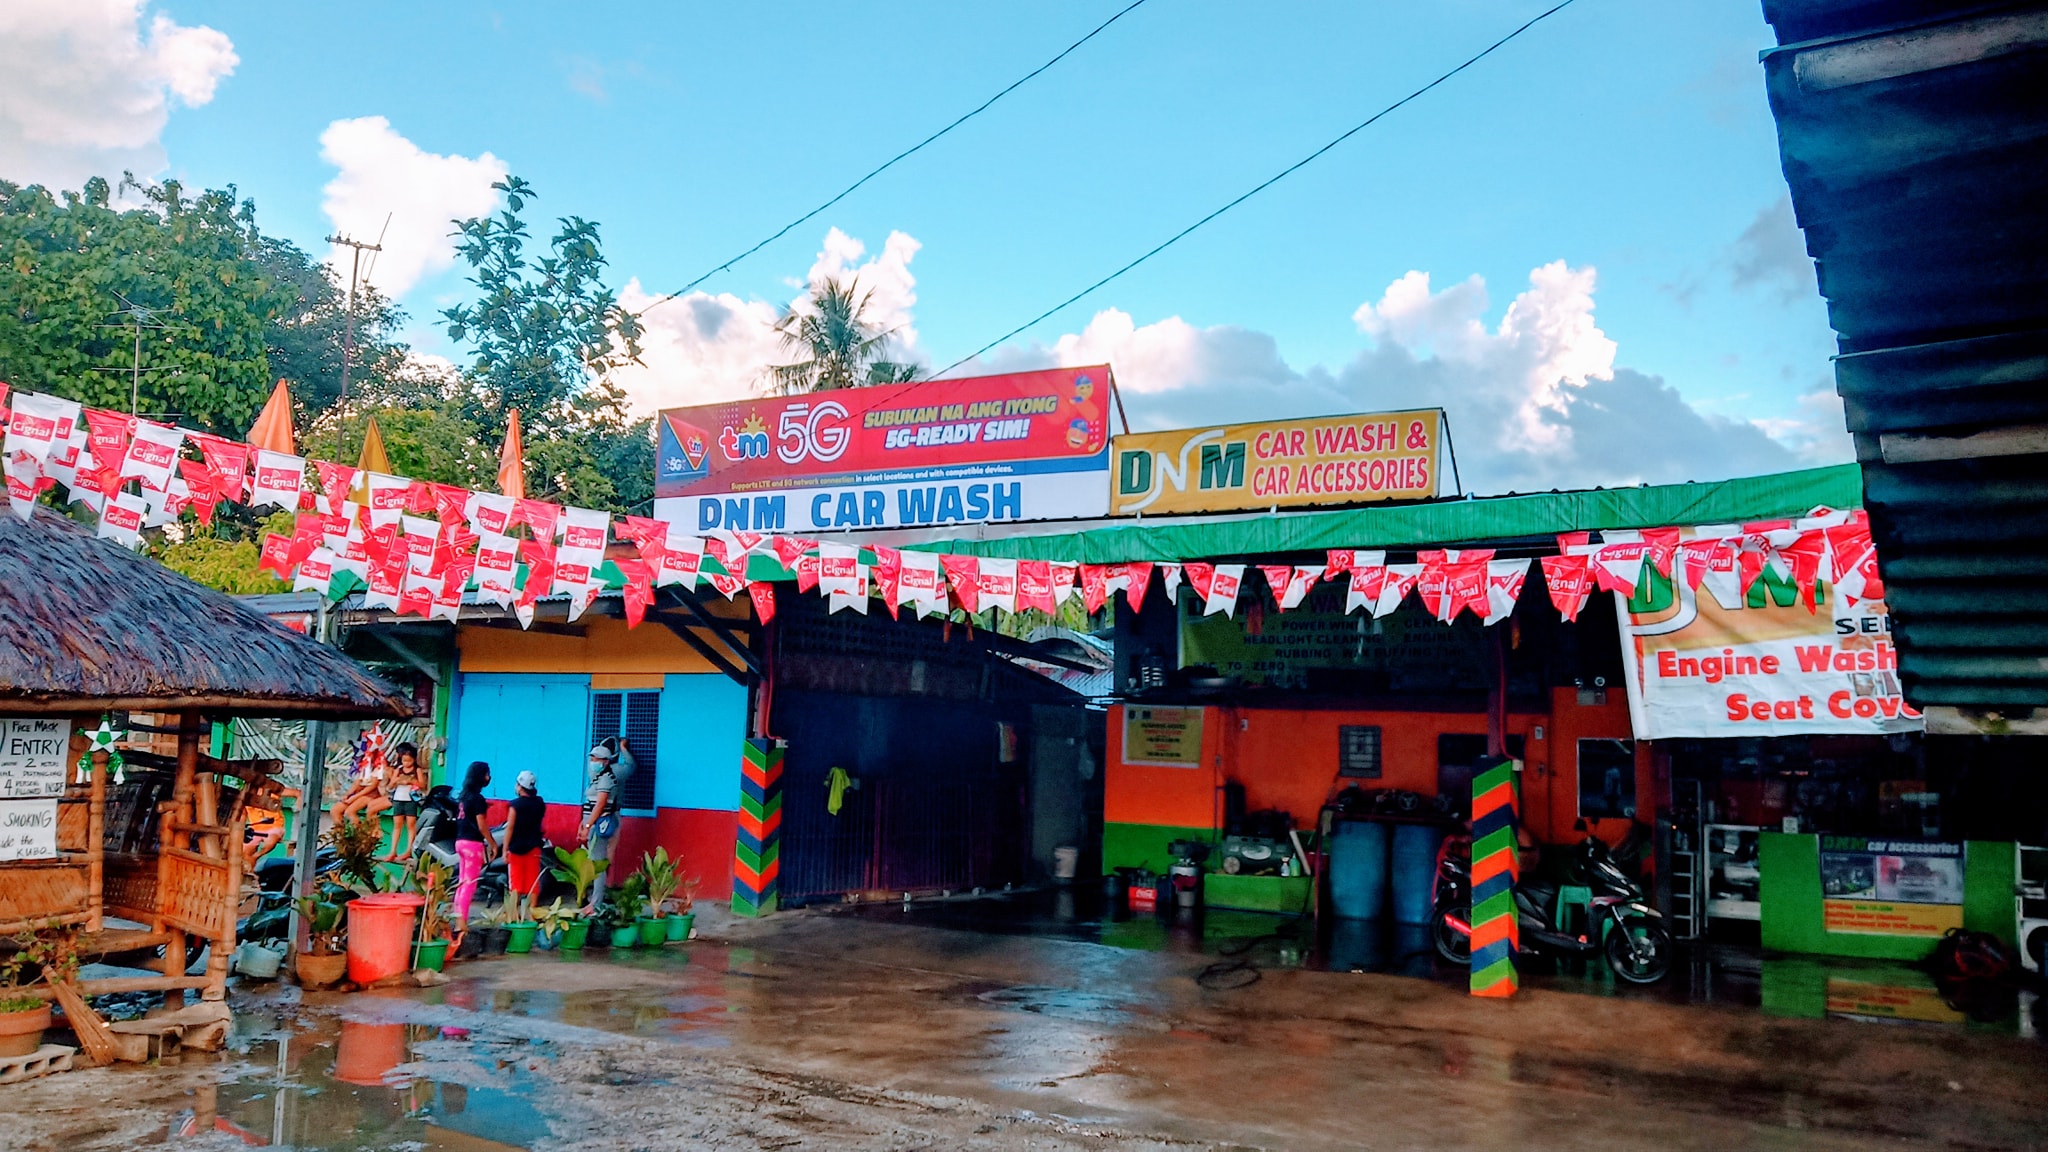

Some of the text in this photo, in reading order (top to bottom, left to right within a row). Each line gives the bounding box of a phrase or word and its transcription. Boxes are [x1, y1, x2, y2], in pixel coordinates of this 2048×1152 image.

[863, 396, 1058, 429] SUBUKAN NA ANG IYONG
[12, 422, 51, 438] Cignal
[719, 400, 850, 464] tm 5G
[884, 418, 1031, 450] 5G-READY SIM!
[93, 434, 119, 446] gnal
[1255, 420, 1428, 459] CAR WASH &
[133, 447, 170, 465] Cignal
[793, 478, 820, 486] network
[863, 474, 883, 482] select
[884, 471, 914, 481] locations
[915, 470, 928, 478] and
[929, 468, 945, 477] with
[945, 466, 984, 477] compatible
[984, 464, 1014, 474] devices.
[1119, 429, 1247, 513] DNM
[1252, 457, 1429, 497] CAR ACCESSORIES
[260, 474, 297, 488] Cignal
[324, 472, 338, 494] gnal
[189, 490, 211, 502] gnal
[374, 496, 405, 508] Cigna
[699, 482, 1021, 531] DNM CAR WASH
[106, 511, 137, 528] Cignal
[321, 521, 347, 533] ignal
[406, 540, 430, 553] ignal
[568, 535, 601, 547] Cignal
[347, 548, 366, 558] gnal
[481, 555, 510, 568] Cignal
[666, 557, 696, 570] Cignal
[723, 562, 742, 572] gnal
[302, 564, 328, 577] Cignal
[557, 569, 586, 581] Cignal
[824, 564, 854, 576] Cignal
[903, 575, 932, 587] Cignal
[1354, 568, 1382, 589] Cignal
[982, 582, 1011, 593] Cignal
[1021, 583, 1049, 593] Cignal
[1243, 634, 1315, 644] HEADLIGHT
[1252, 662, 1285, 671] ZERO
[1658, 649, 1780, 684] Engine
[1726, 694, 1814, 721] Seat
[11, 738, 64, 756] ENTRY
[25, 757, 37, 768] 2
[4, 778, 13, 796] 4
[4, 810, 52, 828] SMOKING
[21, 835, 33, 845] the
[1867, 840, 1886, 852] car
[1887, 842, 1960, 854] accessories
